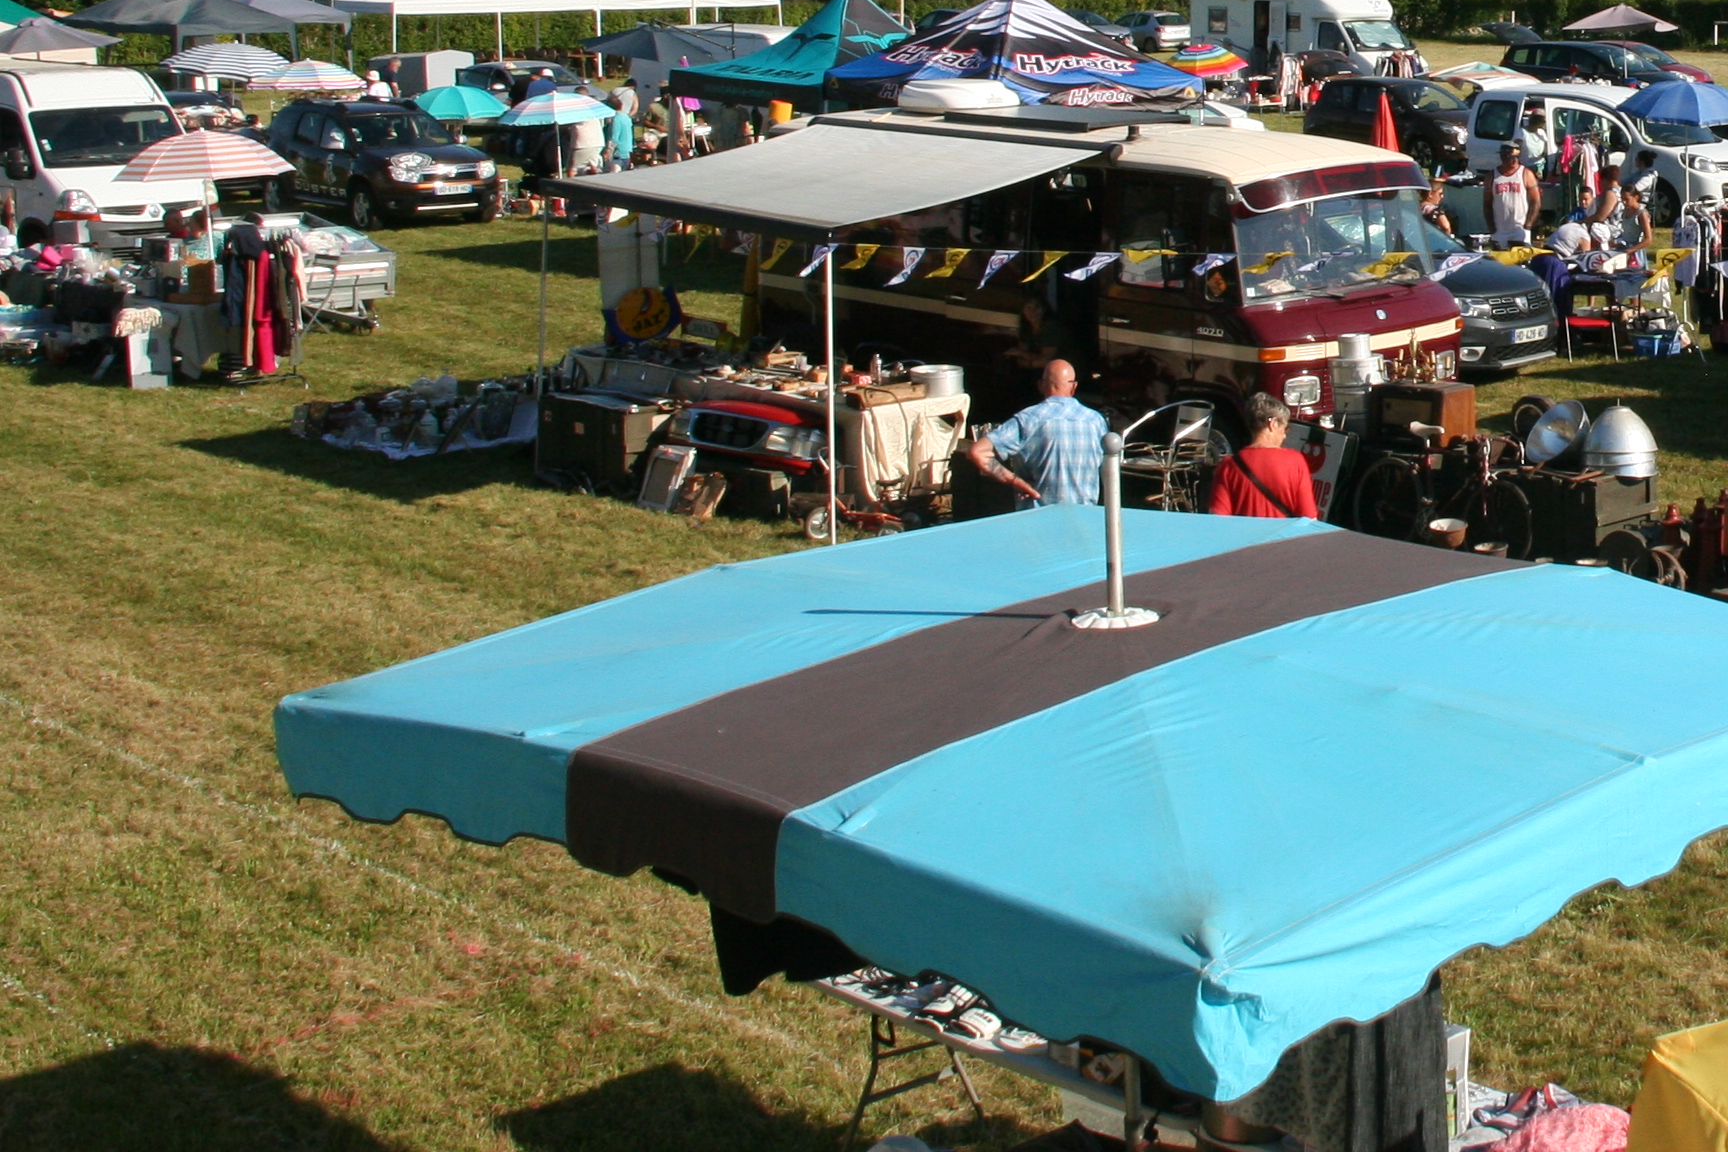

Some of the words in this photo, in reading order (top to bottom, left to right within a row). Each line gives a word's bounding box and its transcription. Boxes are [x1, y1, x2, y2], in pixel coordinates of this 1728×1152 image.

[1016, 53, 1135, 75] Hytrack
[1068, 87, 1133, 106] Hytrack
[295, 180, 347, 197] DUSTER
